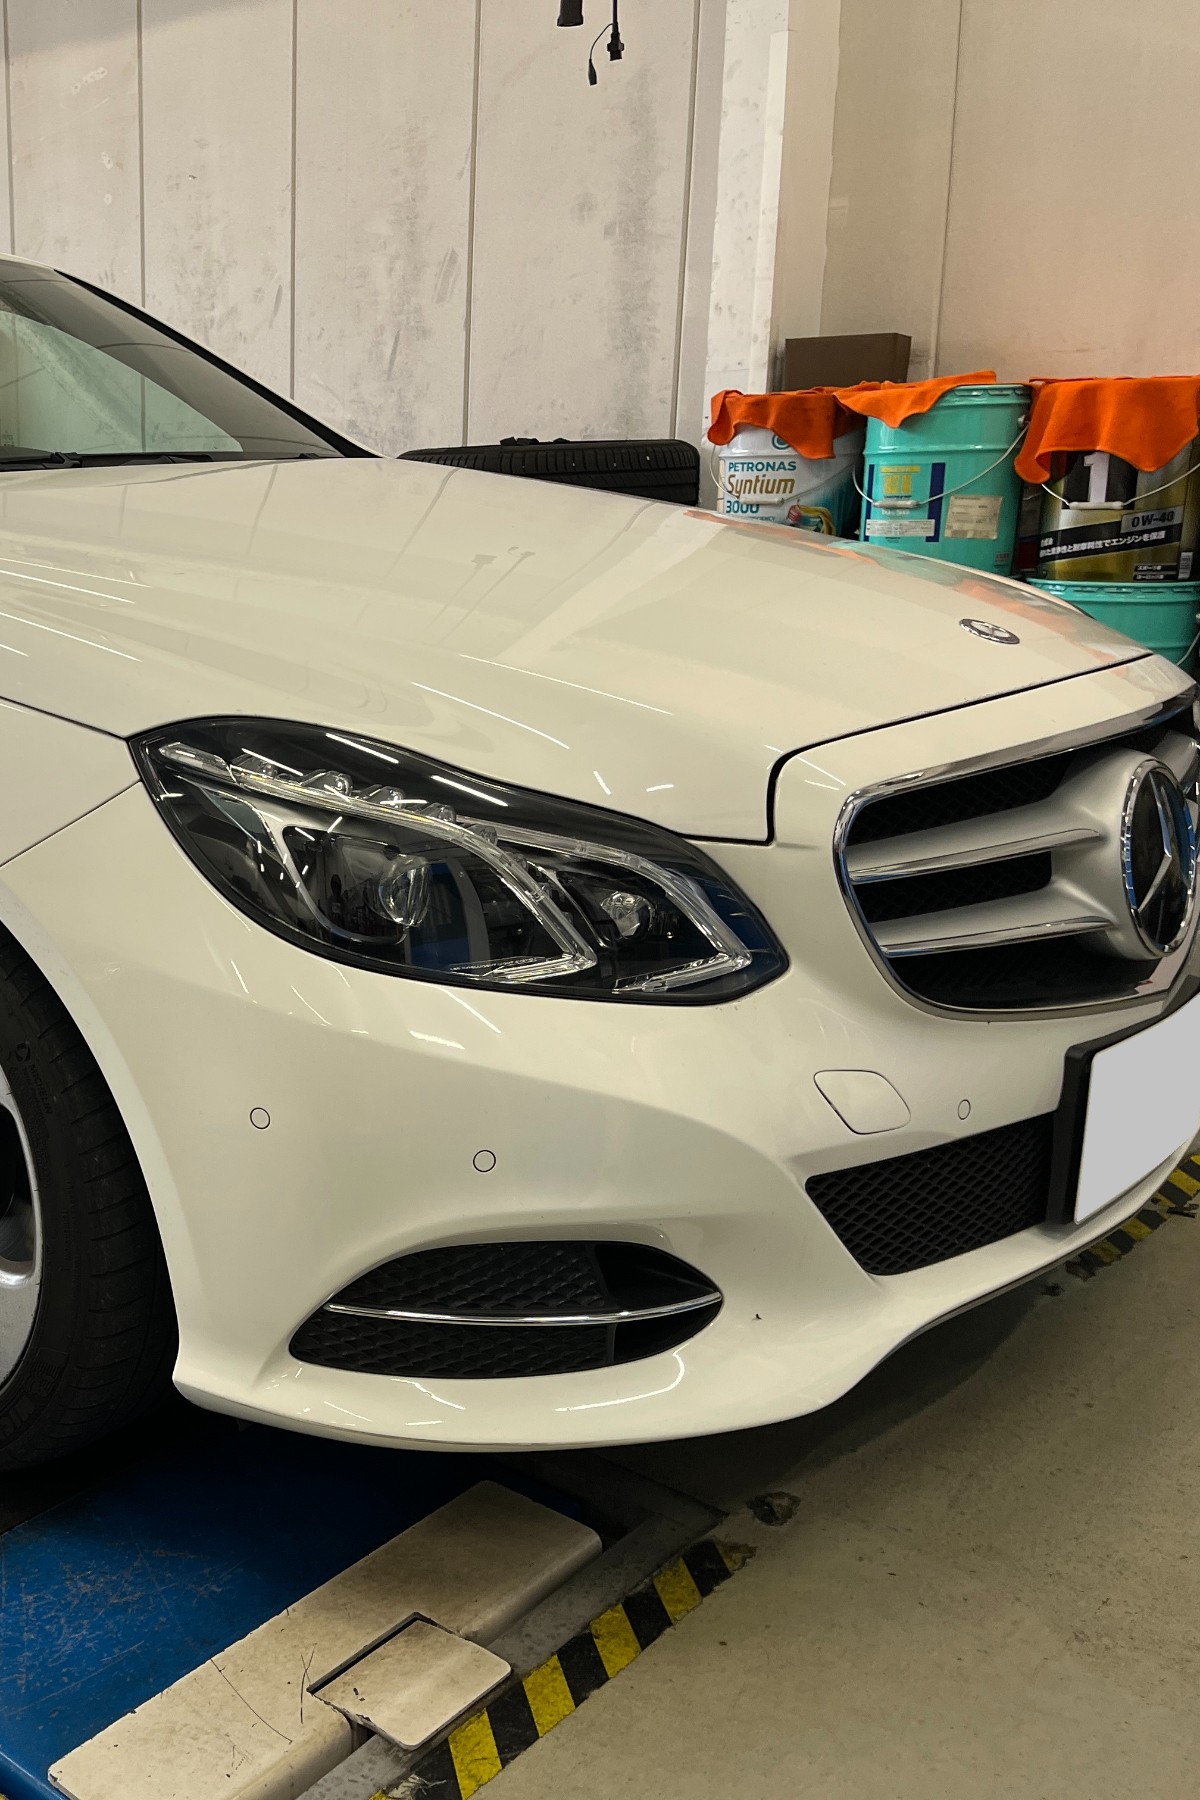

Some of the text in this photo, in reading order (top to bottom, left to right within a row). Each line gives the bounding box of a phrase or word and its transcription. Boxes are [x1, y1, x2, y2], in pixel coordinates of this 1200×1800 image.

[728, 460, 797, 472] PETRONAS
[727, 474, 796, 498] Syntium
[1084, 452, 1110, 502] 1
[725, 500, 760, 514] 3000
[1131, 511, 1176, 528] 0W-40
[28, 1063, 54, 1114] MICHELIN
